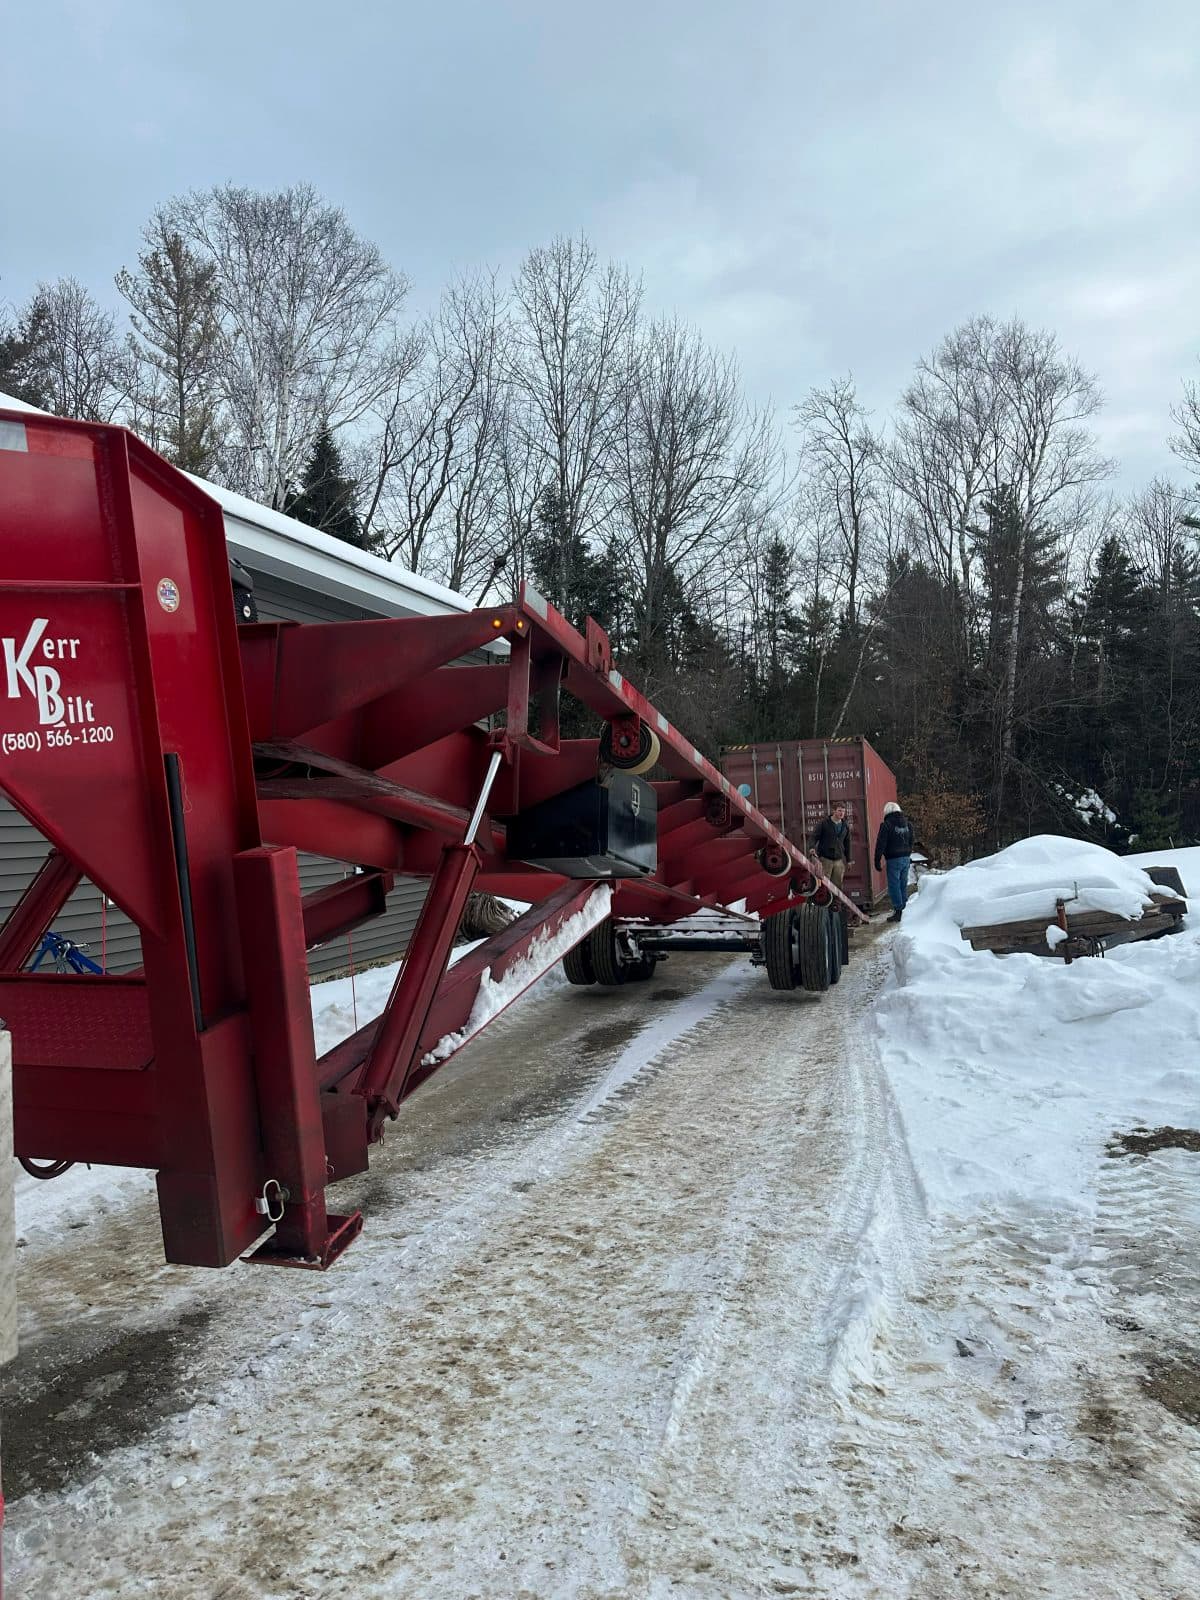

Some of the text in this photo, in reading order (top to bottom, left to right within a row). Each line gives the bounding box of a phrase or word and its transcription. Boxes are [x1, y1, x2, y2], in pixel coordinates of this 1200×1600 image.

[2, 617, 80, 698] Kerr
[34, 666, 95, 727] Bilt
[2, 726, 114, 755] (580) 566-1200
